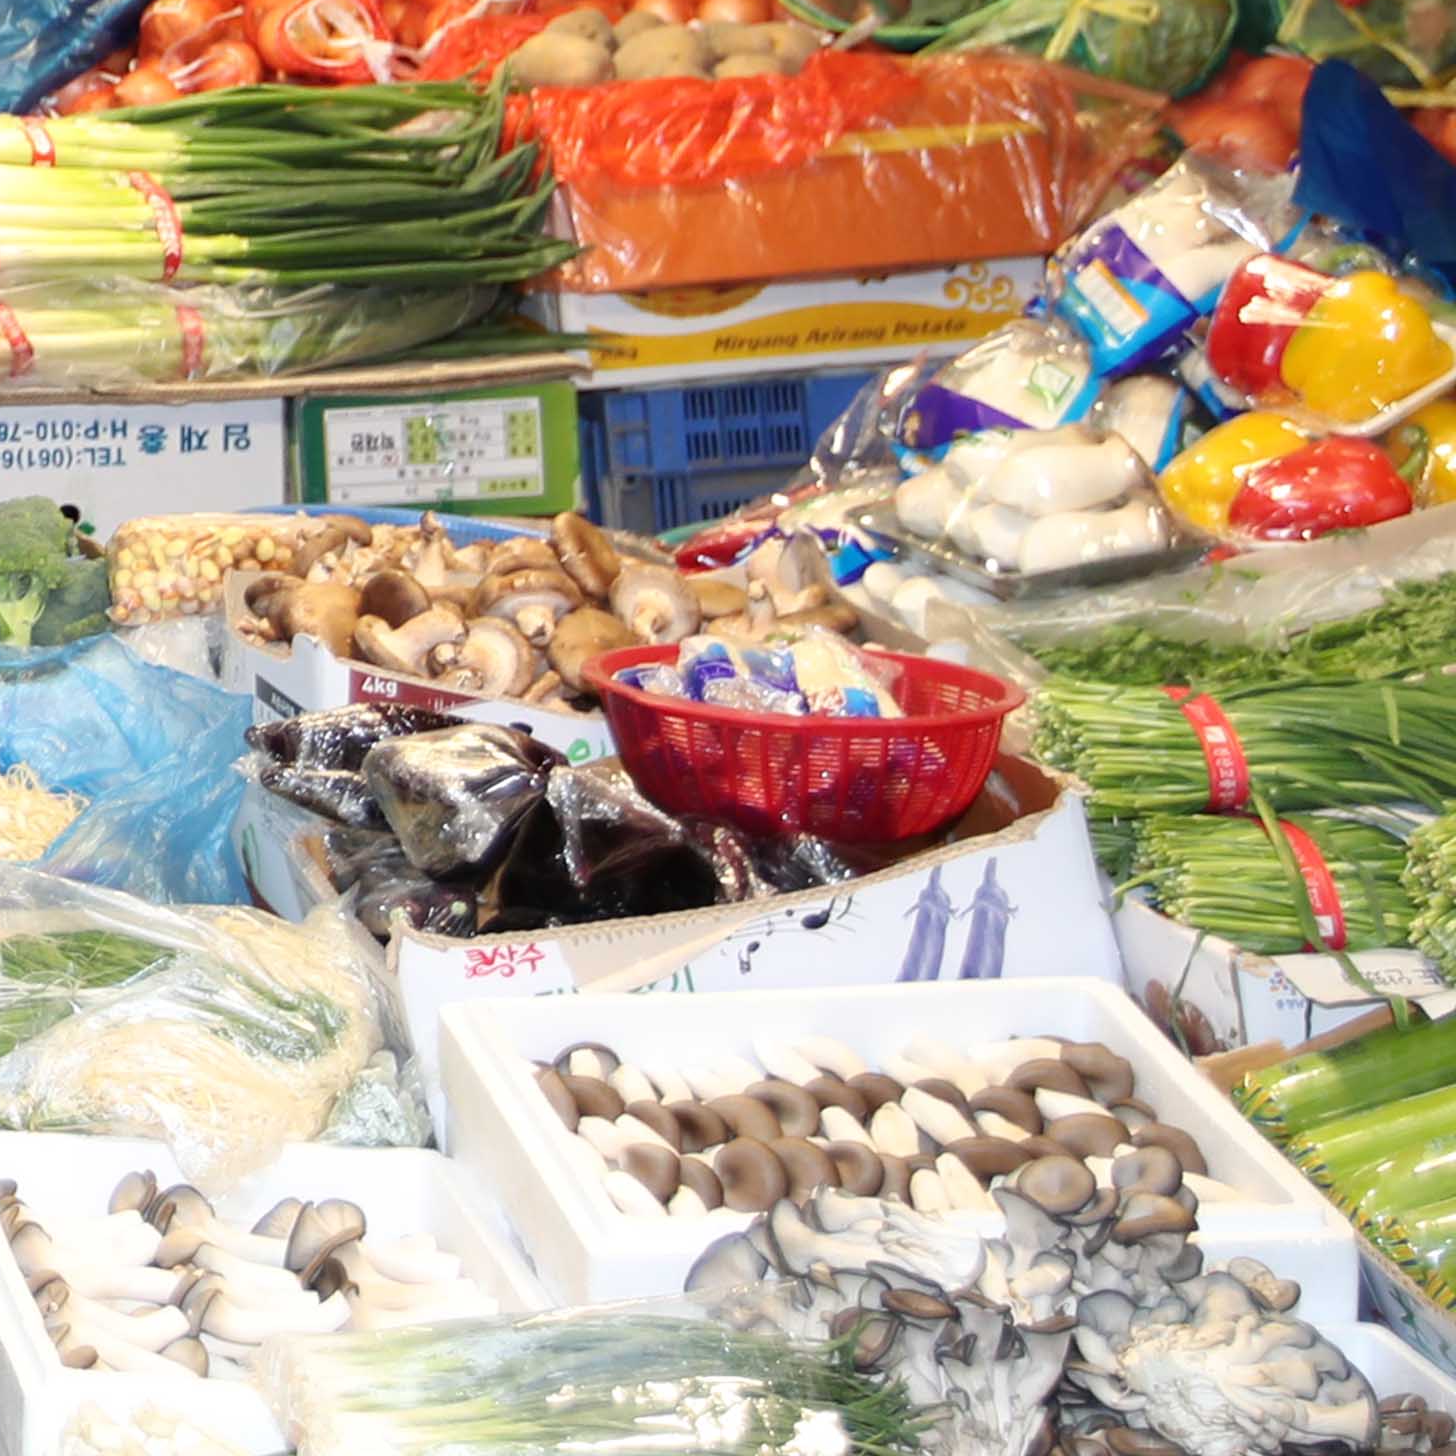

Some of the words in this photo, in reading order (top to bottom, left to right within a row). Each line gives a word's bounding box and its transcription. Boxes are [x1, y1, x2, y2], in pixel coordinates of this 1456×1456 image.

[805, 324, 887, 346] Arirang
[893, 316, 968, 337] Potato
[361, 675, 399, 698] 4kg
